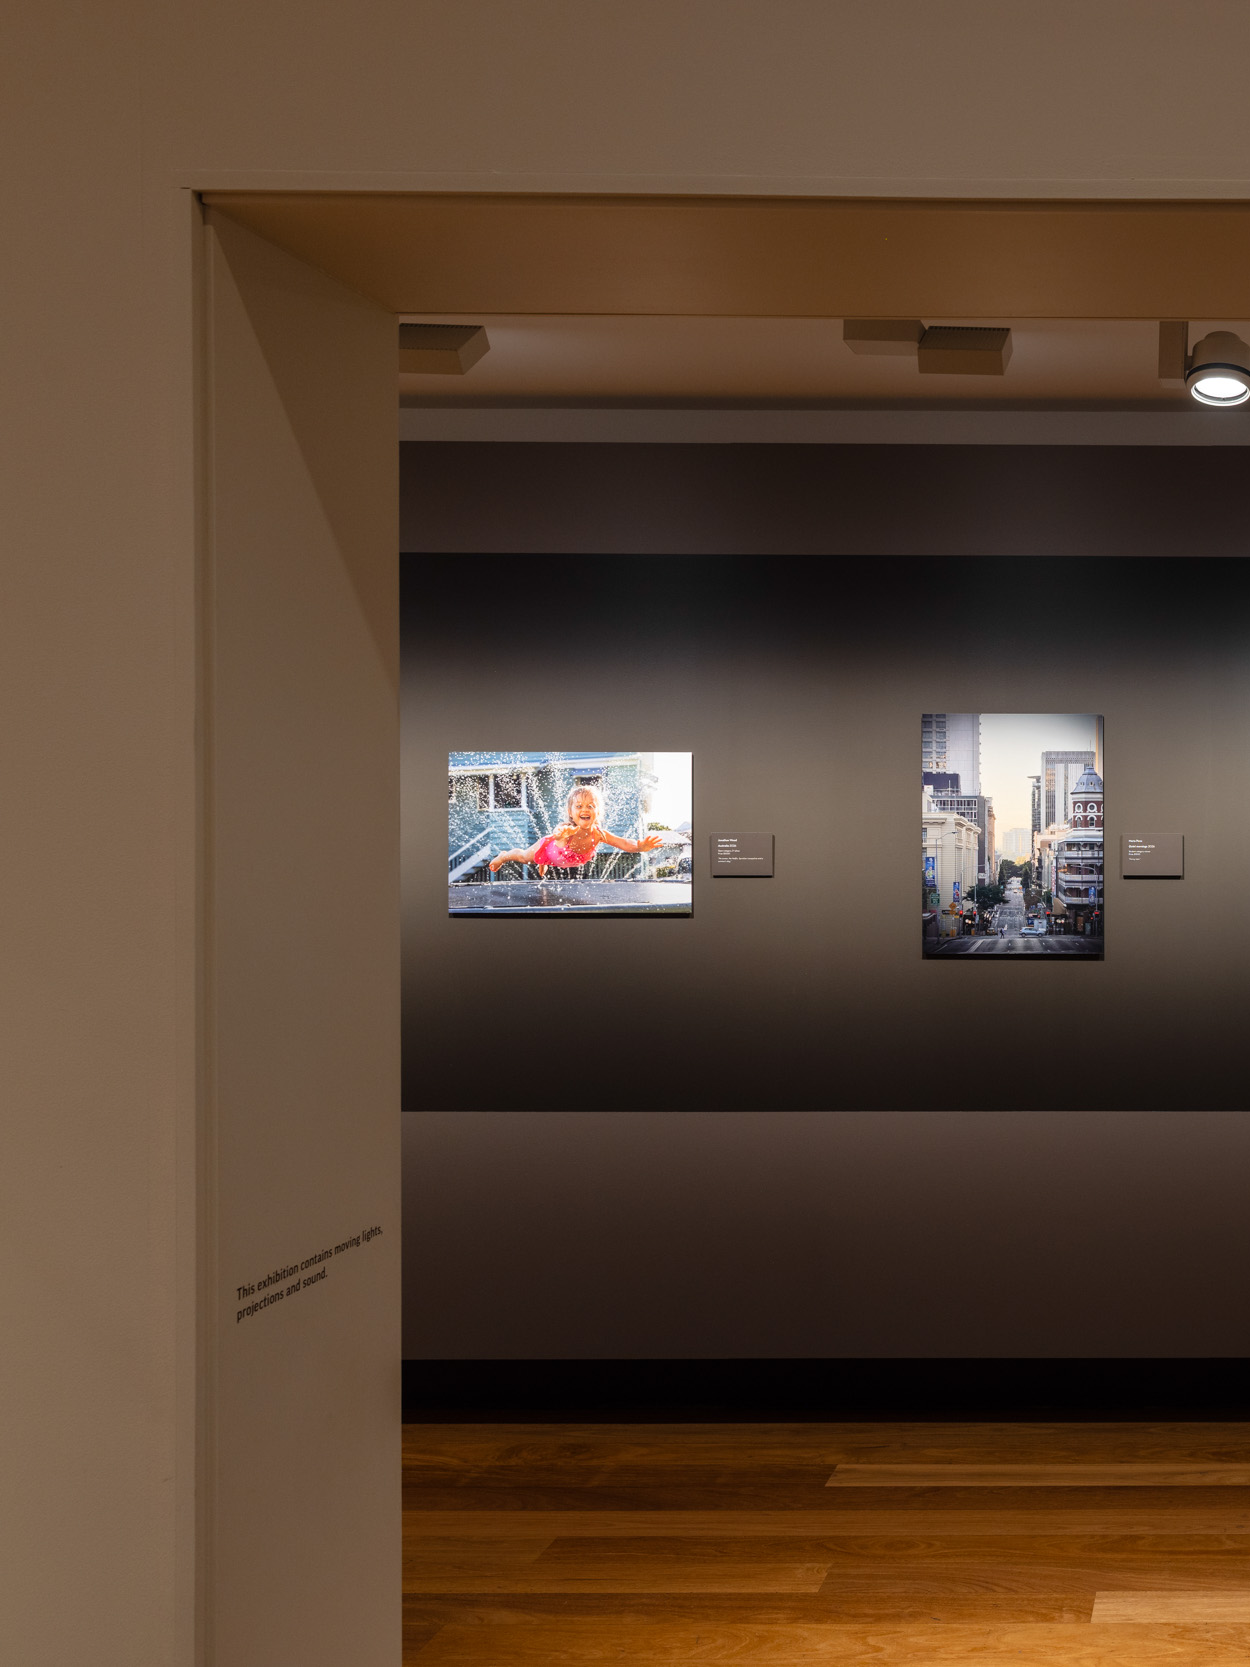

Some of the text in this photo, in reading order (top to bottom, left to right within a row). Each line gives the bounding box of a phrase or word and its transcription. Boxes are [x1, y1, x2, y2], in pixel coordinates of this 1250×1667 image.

[236, 1225, 383, 1300] This exhibition contains moving lights,
[236, 1266, 328, 1324] projections and sound.
